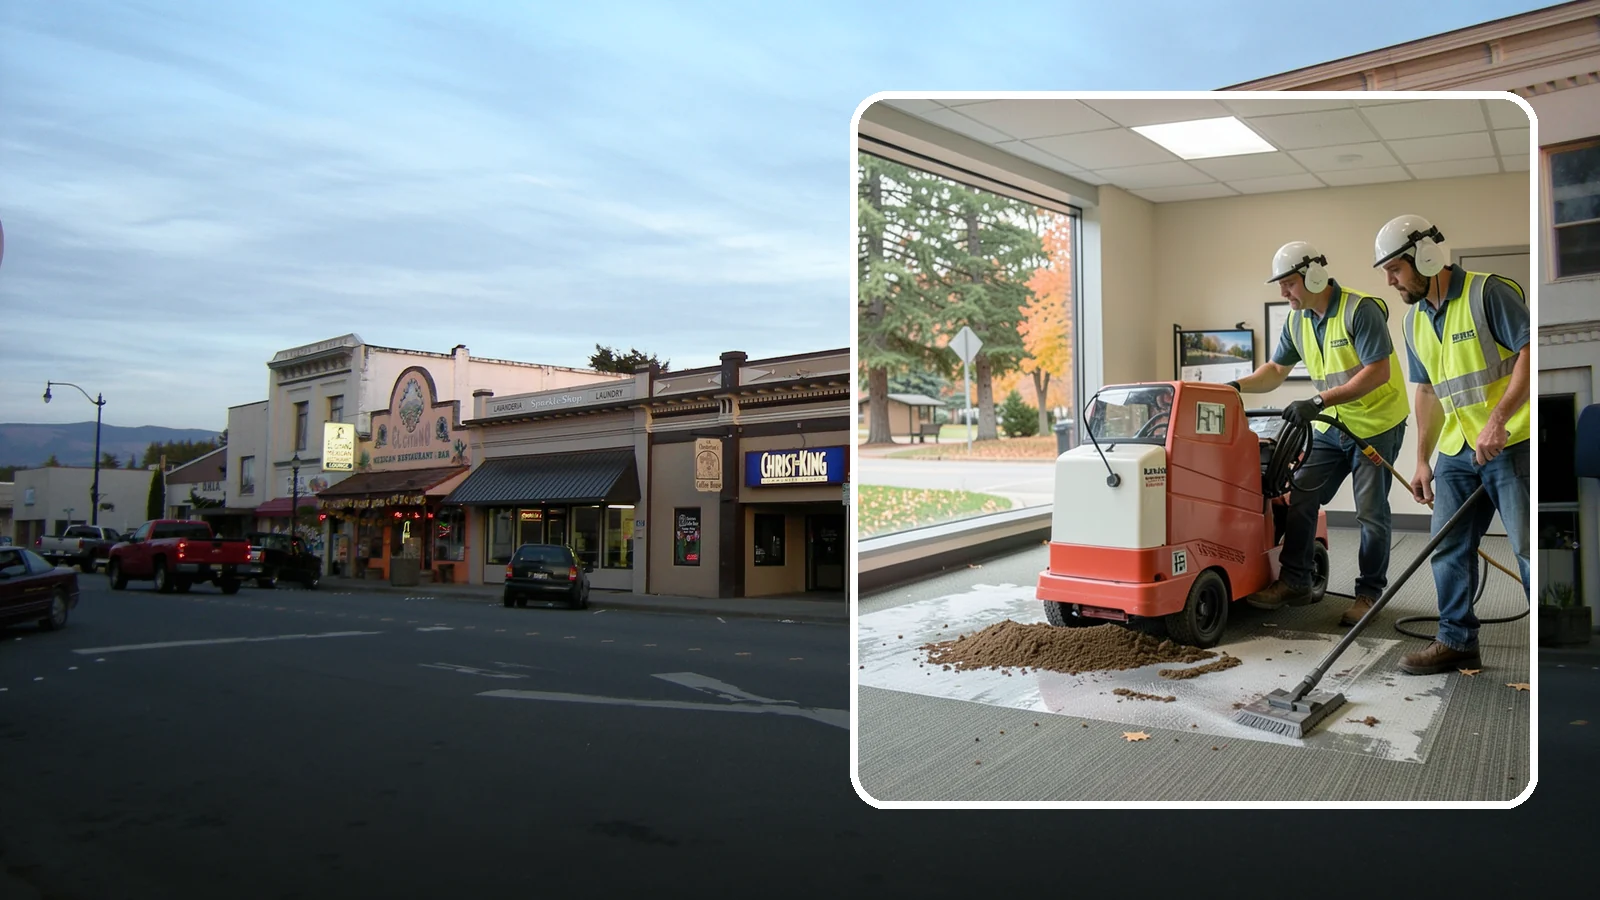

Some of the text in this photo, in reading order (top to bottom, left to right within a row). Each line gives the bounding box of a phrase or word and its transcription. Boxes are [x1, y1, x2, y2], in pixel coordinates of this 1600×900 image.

[531, 394, 582, 408] Sparkle Shop
[596, 389, 623, 400] LAUNDRY
[493, 402, 522, 412] LAVANDERIA
[374, 455, 396, 464] MEXICAN
[398, 451, 433, 462] RESTAURANT
[438, 450, 450, 458] BAR
[761, 450, 827, 477] CHRIST KING
